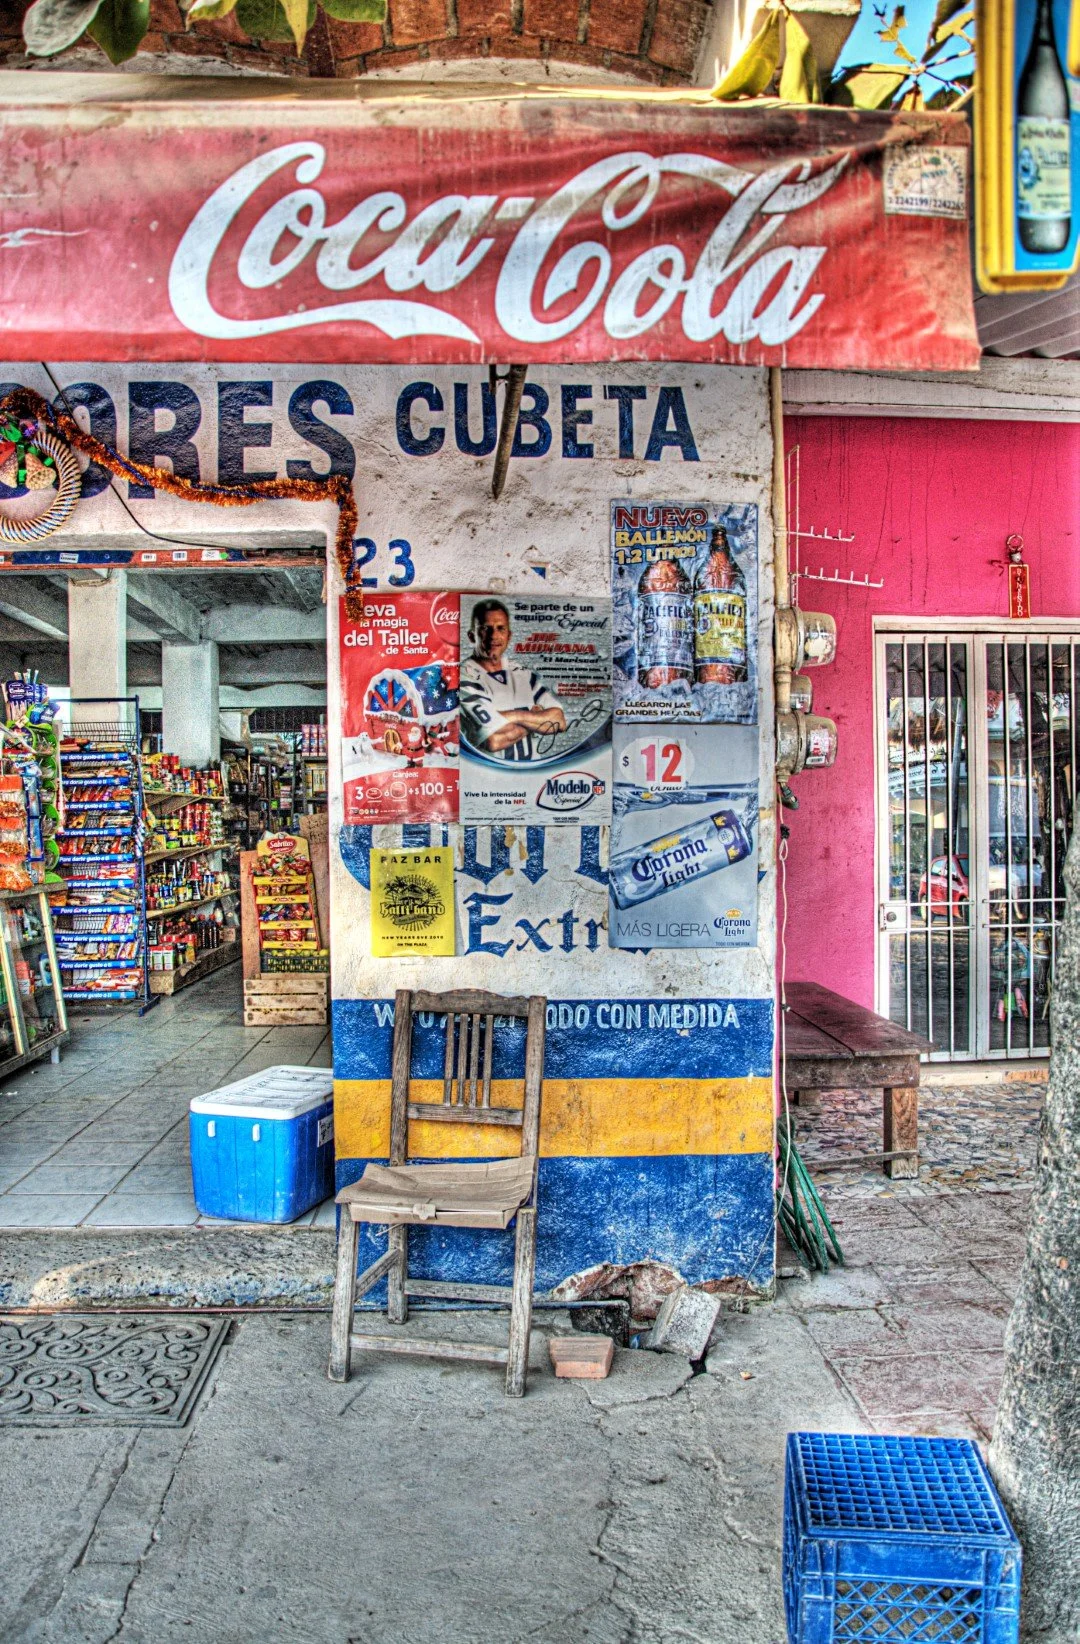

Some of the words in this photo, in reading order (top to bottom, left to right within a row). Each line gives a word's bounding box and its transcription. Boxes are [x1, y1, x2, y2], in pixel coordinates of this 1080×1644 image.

[168, 141, 851, 346] Coca-Cola
[396, 381, 701, 462] CUBETA
[615, 507, 709, 528] NUEVO
[615, 528, 708, 547] BALLENÓN
[615, 549, 642, 565] 1.2
[646, 547, 697, 563] LITROS
[363, 603, 396, 617] eva
[514, 602, 528, 611] Se
[530, 603, 561, 613] parte
[562, 603, 577, 612] de
[372, 617, 409, 628] magia
[514, 612, 552, 623] equipo
[553, 612, 609, 631] Especial
[344, 630, 373, 647] del
[378, 629, 429, 646] Taller
[385, 646, 399, 655] de
[403, 646, 428, 655] Santa
[660, 709, 701, 717] HELADAS
[622, 756, 630, 767] $
[640, 743, 683, 783] 12
[355, 786, 364, 800] 3
[546, 779, 590, 796] Modelo
[593, 786, 604, 794] NFL
[269, 840, 294, 849] Sabritas
[381, 856, 407, 864] PAZ
[413, 856, 442, 864] BAR
[632, 839, 708, 881] Corona
[658, 862, 701, 888] Light
[464, 892, 651, 955] Extr
[617, 920, 652, 937] MÁS
[657, 922, 711, 937] LIGERA
[713, 916, 751, 930] Corona
[724, 927, 745, 937] Light
[546, 1003, 586, 1029] ODO
[596, 1003, 642, 1030] CON
[648, 1003, 741, 1030] MEDIDA
